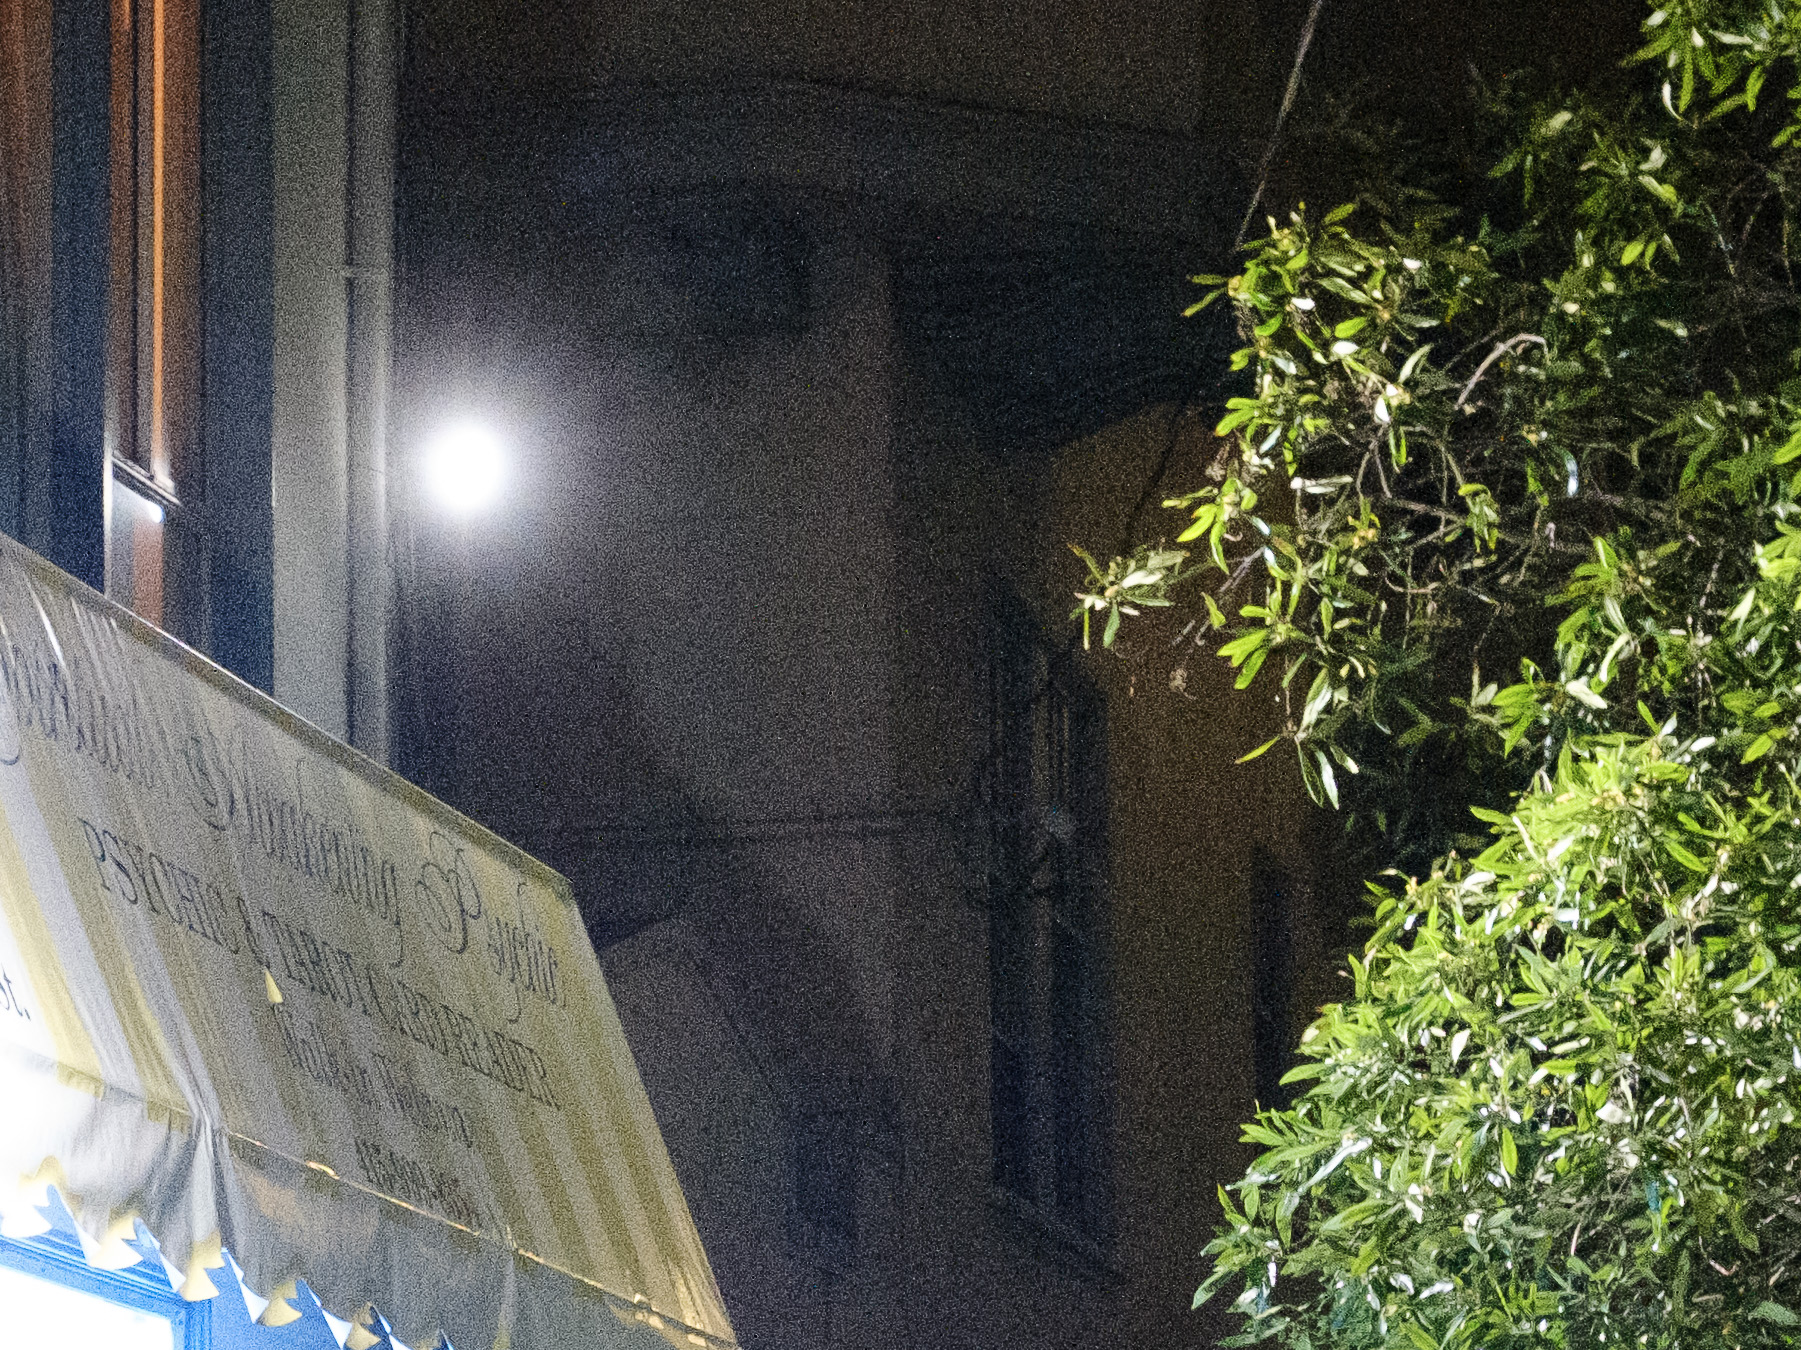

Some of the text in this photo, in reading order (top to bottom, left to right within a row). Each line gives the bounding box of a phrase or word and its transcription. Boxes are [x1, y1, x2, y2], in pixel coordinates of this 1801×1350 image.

[79, 817, 561, 1109] PSYCHIC & TAROT CARD READER
[416, 829, 565, 1024] Psychic
